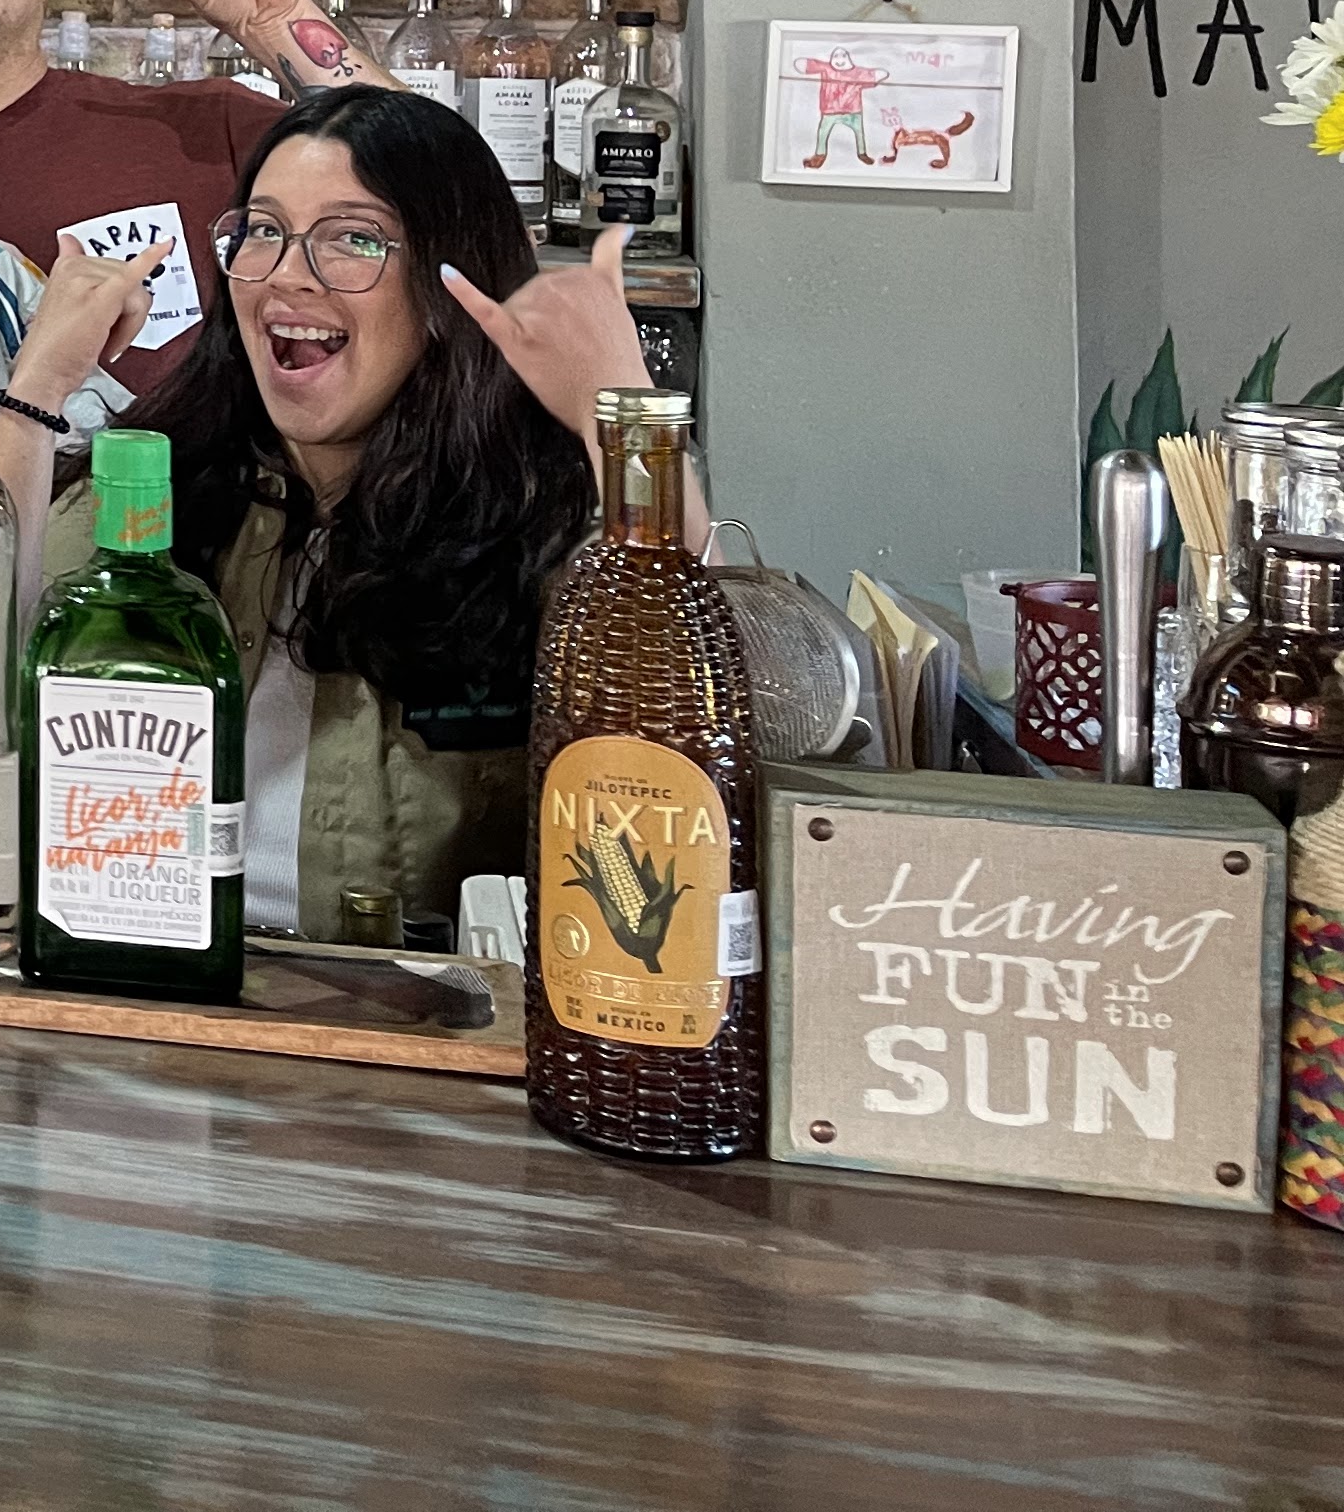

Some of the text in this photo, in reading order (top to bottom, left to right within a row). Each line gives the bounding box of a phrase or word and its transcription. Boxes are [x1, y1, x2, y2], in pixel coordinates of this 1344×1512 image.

[601, 147, 654, 159] AMPARO
[88, 221, 178, 258] APAT
[46, 709, 208, 764] CONTROY
[158, 767, 206, 809] de
[584, 779, 672, 800] JILOTEPEC
[551, 788, 716, 846] NIXTA
[109, 861, 202, 886] ORANGE
[109, 880, 202, 905] LIQUEUR
[828, 858, 1234, 985] Having
[857, 941, 1150, 1023] FUN in
[597, 1012, 666, 1032] MEXICO
[1104, 1004, 1173, 1030] the
[863, 1025, 1178, 1140] SUN
